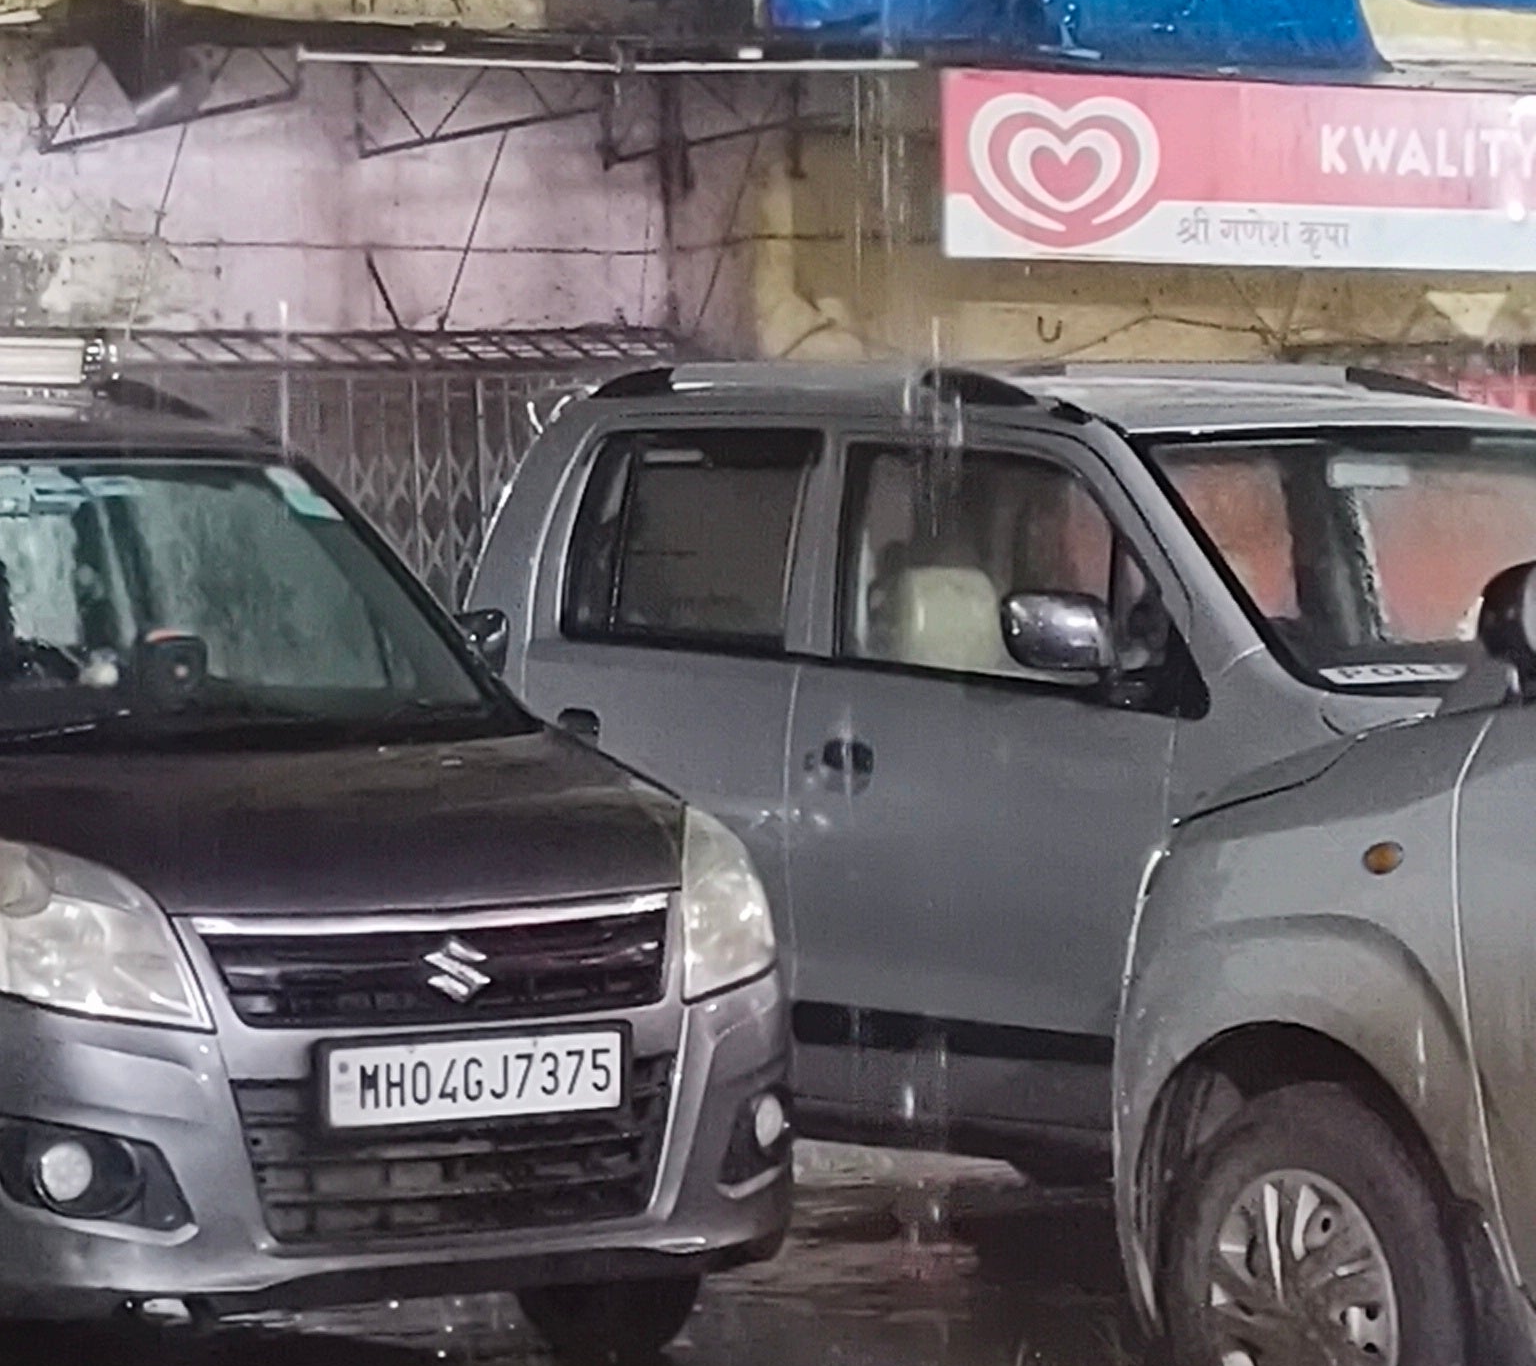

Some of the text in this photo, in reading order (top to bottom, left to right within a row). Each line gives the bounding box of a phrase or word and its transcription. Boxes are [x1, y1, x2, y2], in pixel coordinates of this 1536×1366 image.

[1177, 206, 1350, 260] श्री गणेश कृपा
[359, 1047, 612, 1110] MH04GJ7375
